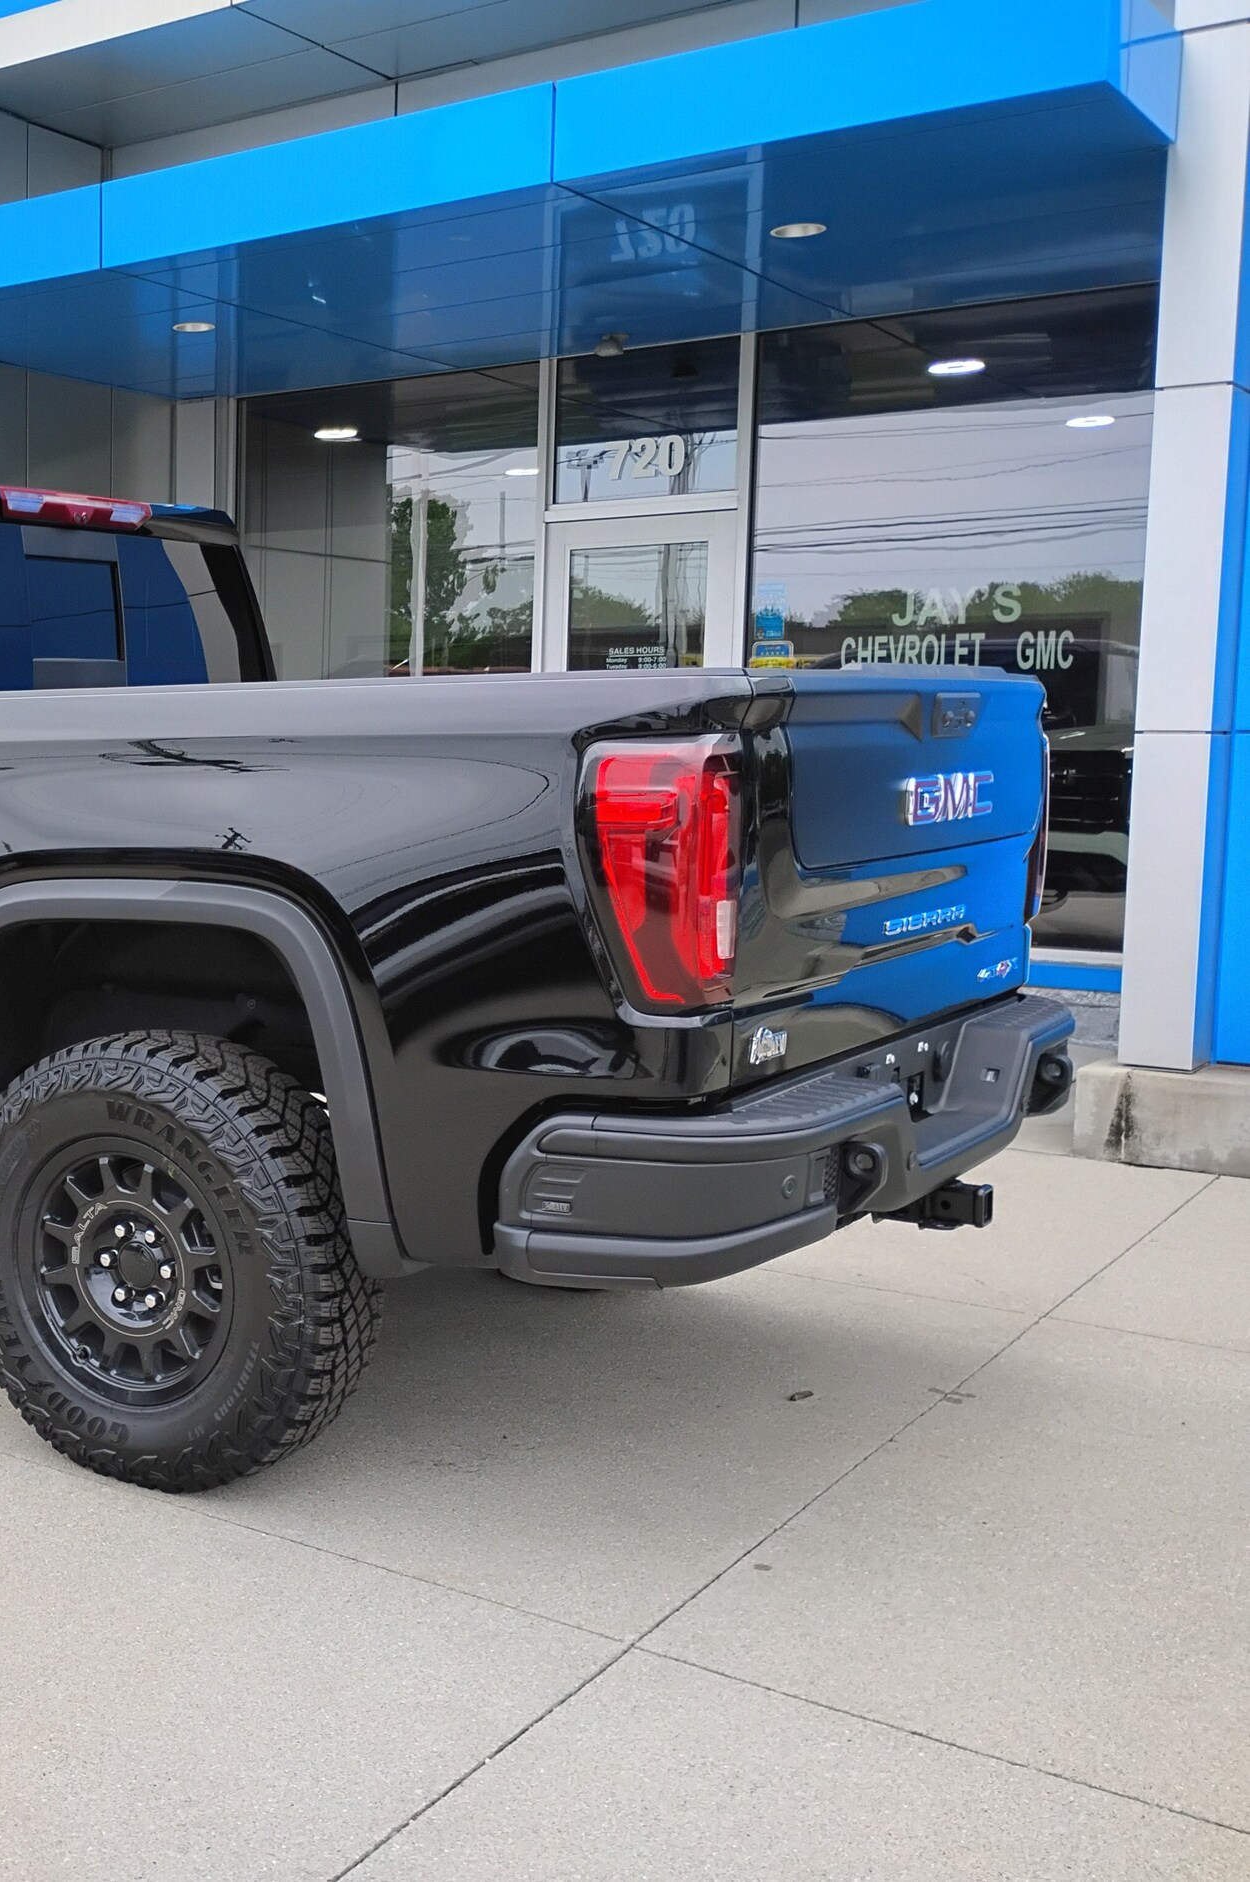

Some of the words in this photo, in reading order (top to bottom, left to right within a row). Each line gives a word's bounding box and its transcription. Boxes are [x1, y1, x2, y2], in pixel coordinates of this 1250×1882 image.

[606, 434, 686, 481] 720
[891, 584, 1022, 627] JAY'S
[609, 647, 635, 655] SALES
[636, 646, 665, 654] HOURS
[1016, 629, 1075, 671] GMC
[905, 770, 994, 826] GMC
[883, 904, 966, 937] SIERRA
[106, 1100, 254, 1255] WRANGLER
[162, 1289, 186, 1330] GMC
